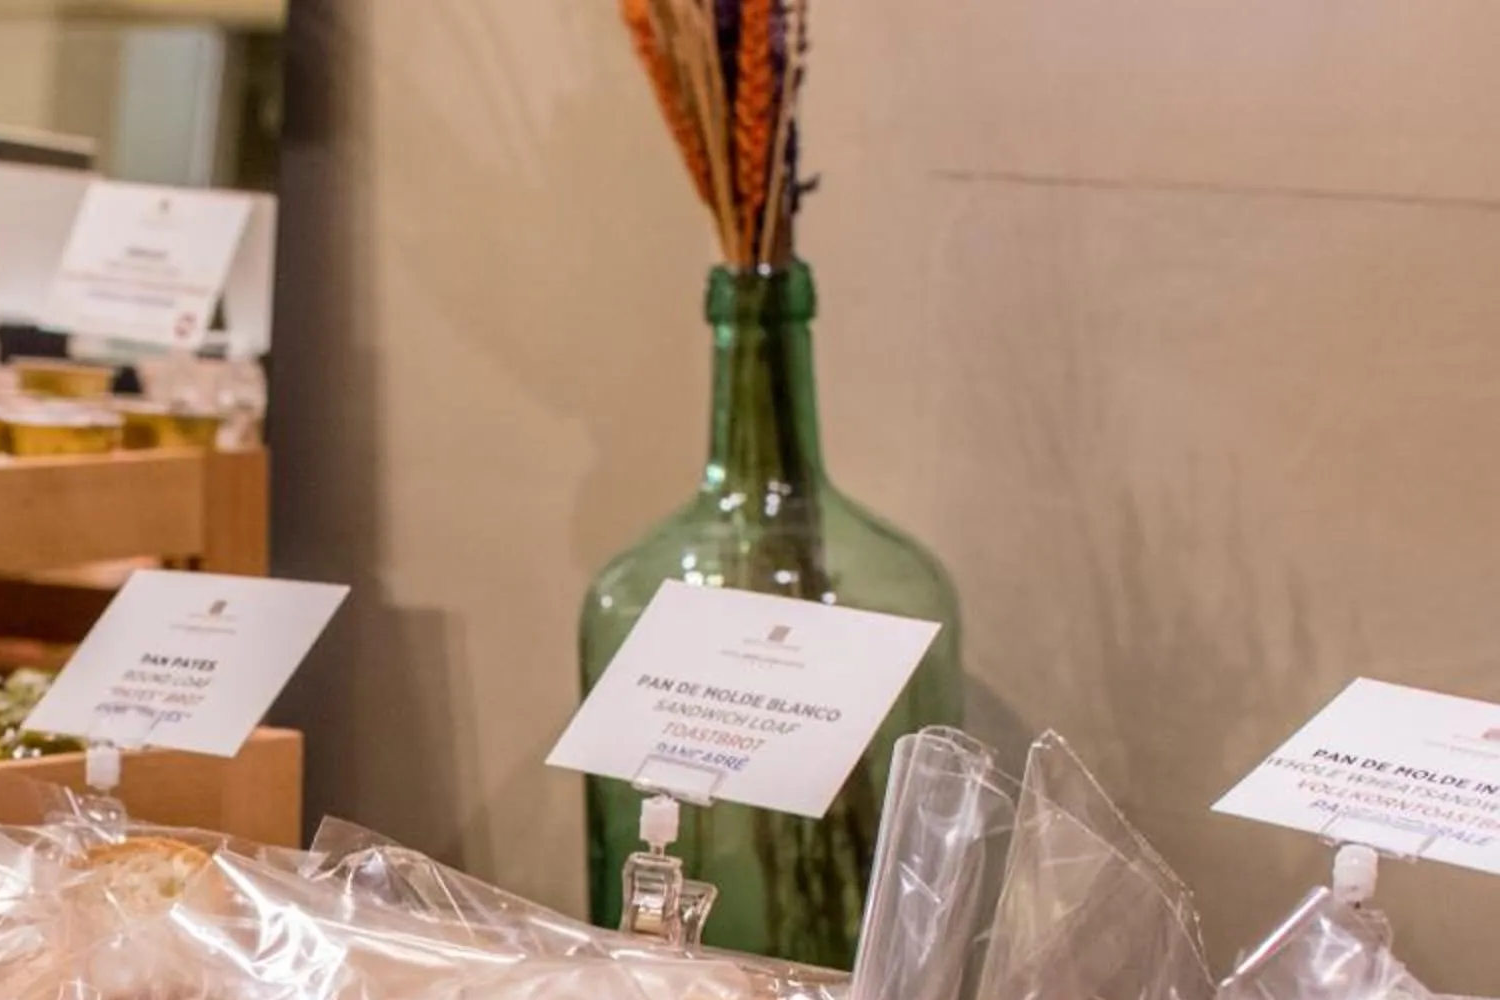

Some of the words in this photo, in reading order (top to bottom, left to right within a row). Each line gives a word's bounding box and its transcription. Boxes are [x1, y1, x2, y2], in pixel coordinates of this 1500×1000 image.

[637, 673, 674, 692] PAN
[676, 680, 701, 697] DE
[703, 685, 765, 709] MOLDE
[766, 697, 843, 723] BLANCO
[653, 698, 749, 727] SANDWICH
[750, 716, 802, 736] LOAF
[661, 720, 767, 751] TOASTBROT
[1266, 756, 1343, 779] WHOLE
[1312, 748, 1359, 766] PAN
[1361, 756, 1392, 773] DE
[1394, 766, 1473, 790] MOLDE
